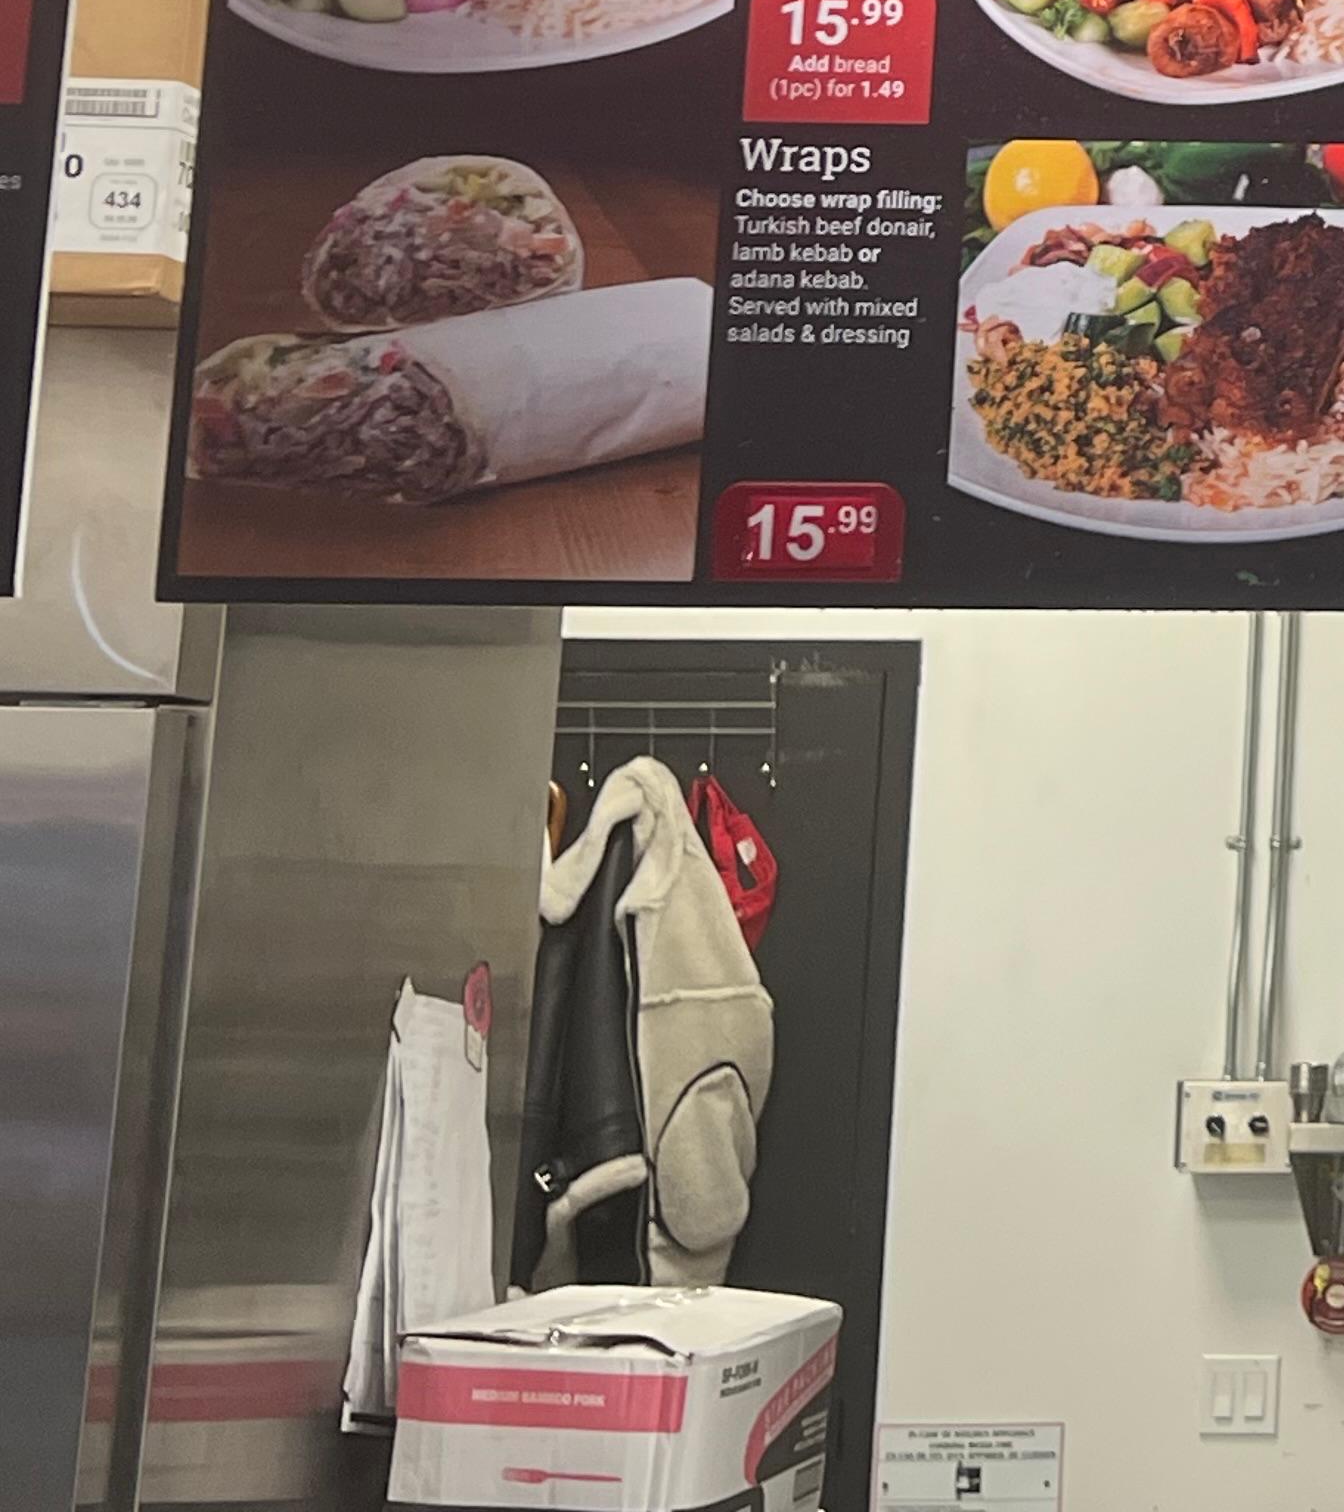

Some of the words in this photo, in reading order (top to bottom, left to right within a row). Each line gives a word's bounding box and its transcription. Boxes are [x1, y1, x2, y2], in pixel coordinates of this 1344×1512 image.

[787, 54, 830, 73] Add
[833, 54, 891, 74] bread
[770, 78, 822, 100] (1pc)
[826, 78, 856, 98] for
[860, 80, 905, 99] 1.49
[739, 138, 871, 181] Wraps
[103, 191, 141, 208] 434
[735, 188, 816, 209] Choose
[820, 194, 872, 213] wrap
[876, 189, 943, 215] filling:
[746, 503, 878, 563] 15.99
